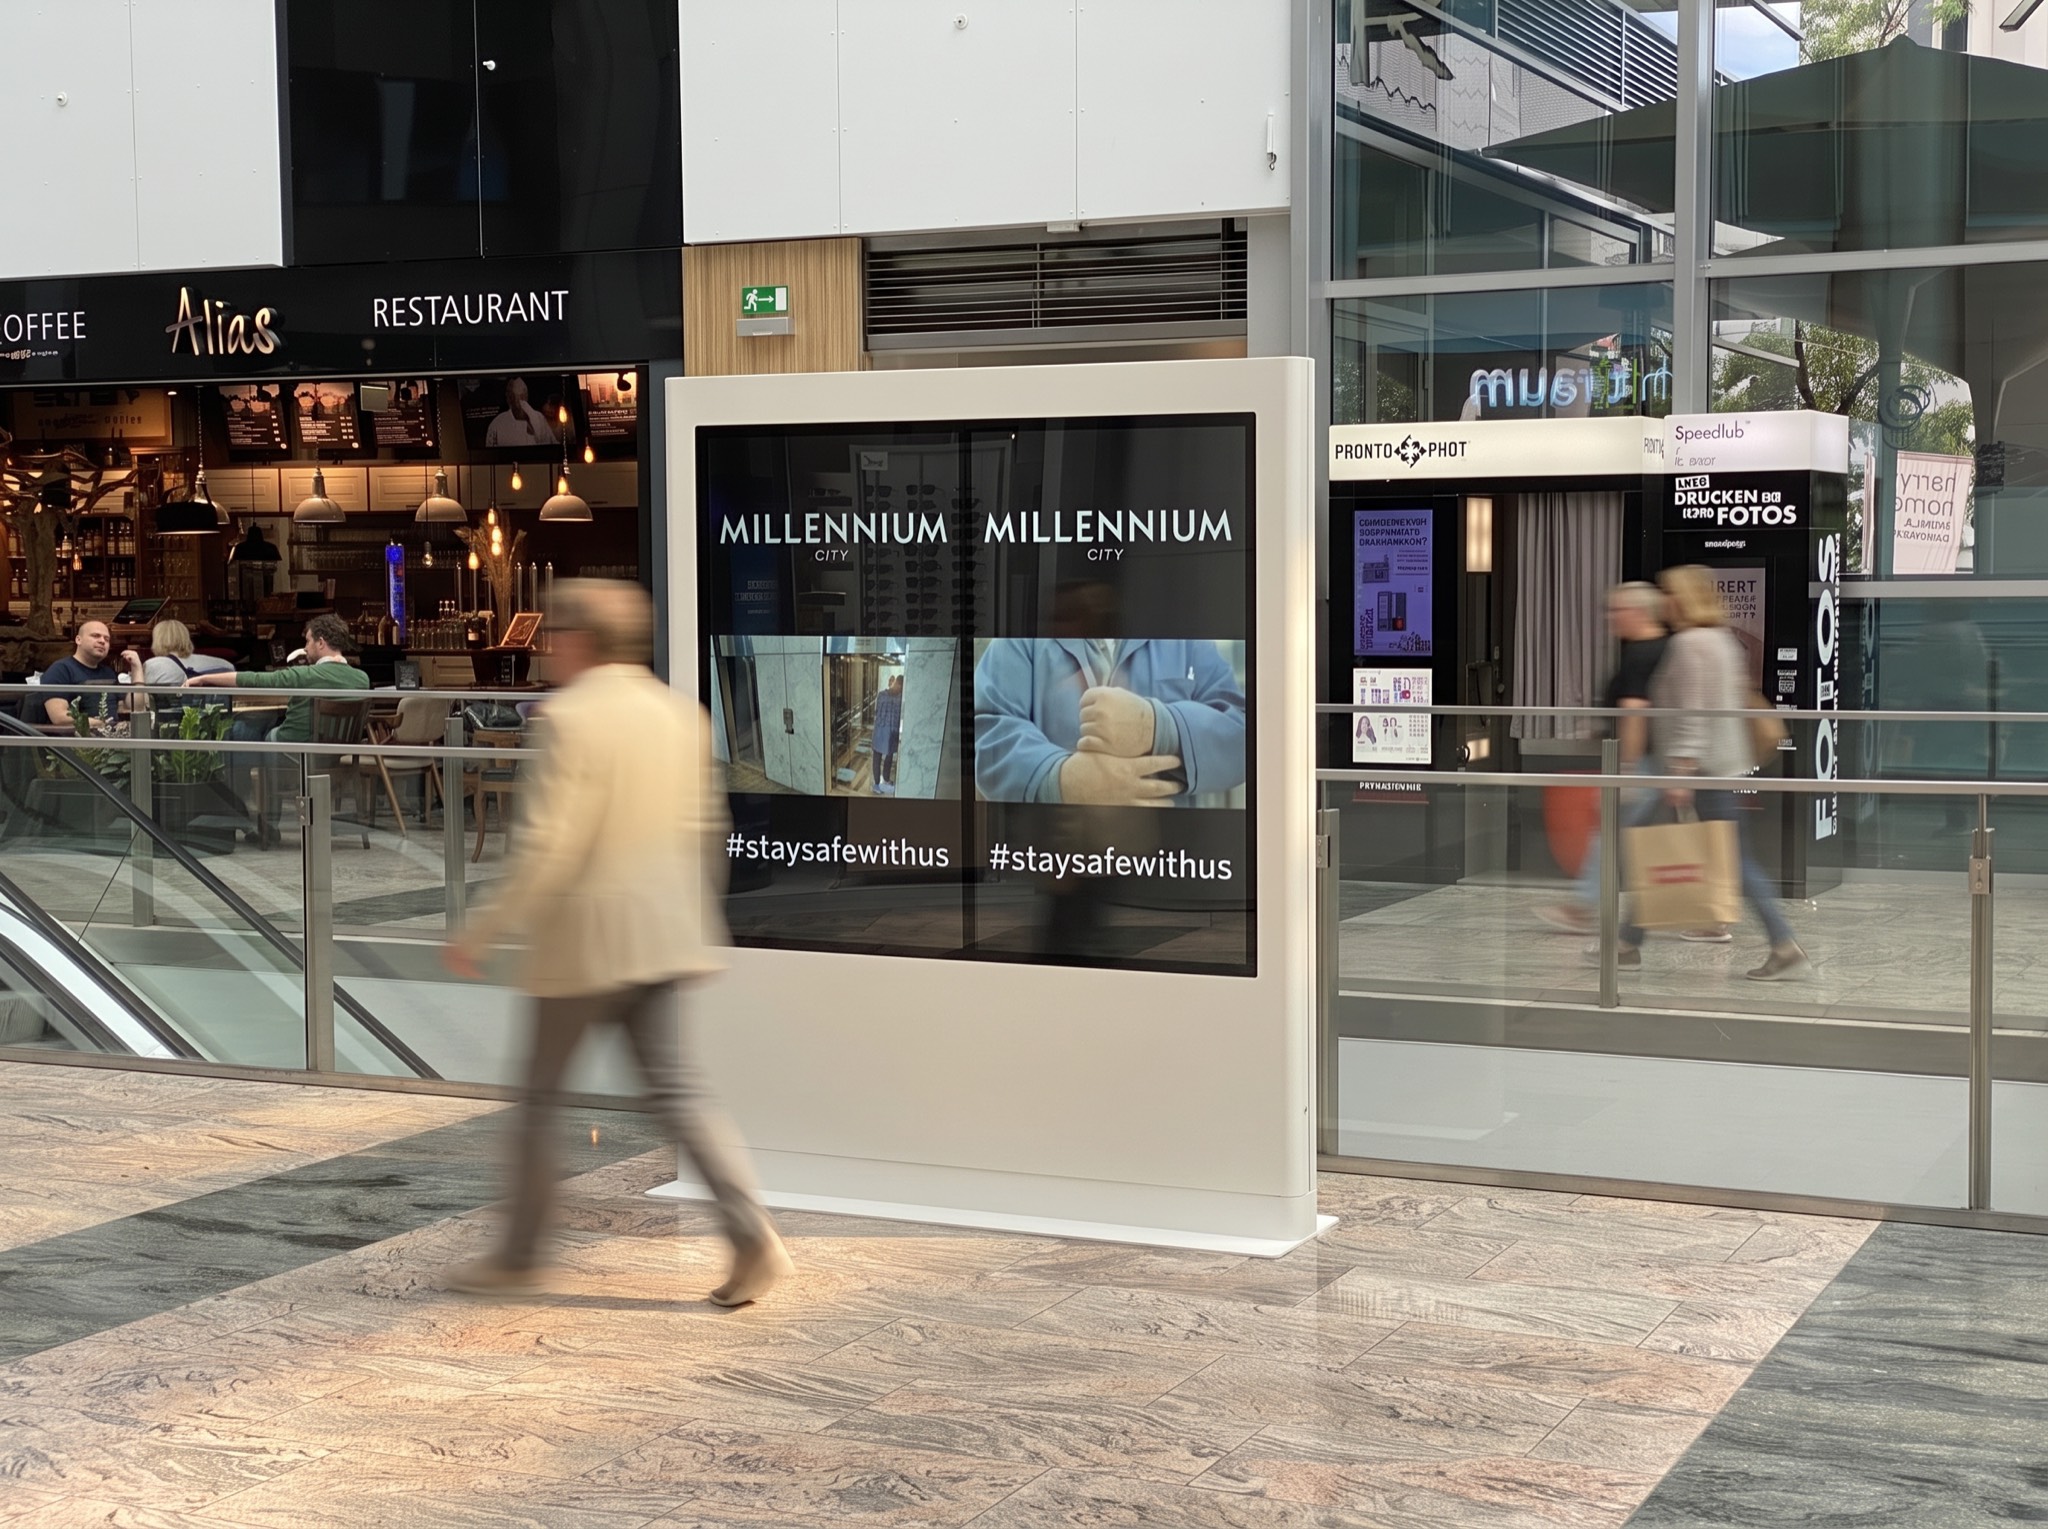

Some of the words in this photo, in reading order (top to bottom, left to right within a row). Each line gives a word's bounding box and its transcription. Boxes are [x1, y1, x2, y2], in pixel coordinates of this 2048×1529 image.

[165, 286, 282, 356] Alias
[374, 291, 568, 327] RESTAURANT
[0, 312, 86, 344] OFFEE
[1676, 421, 1743, 443] Speedlub
[1336, 444, 1392, 459] PRONTO
[1675, 490, 1757, 505] DRUCKEN
[721, 513, 947, 543] MILLENNIUM
[985, 510, 1231, 543] MILLENNIUM
[1718, 505, 1796, 525] FOTOS
[815, 550, 848, 561] CITY
[1088, 549, 1123, 560] CITY
[1815, 534, 1836, 841] FOTOS
[727, 833, 948, 867] #staysafewithus
[990, 844, 1232, 879] #staysafewithus
